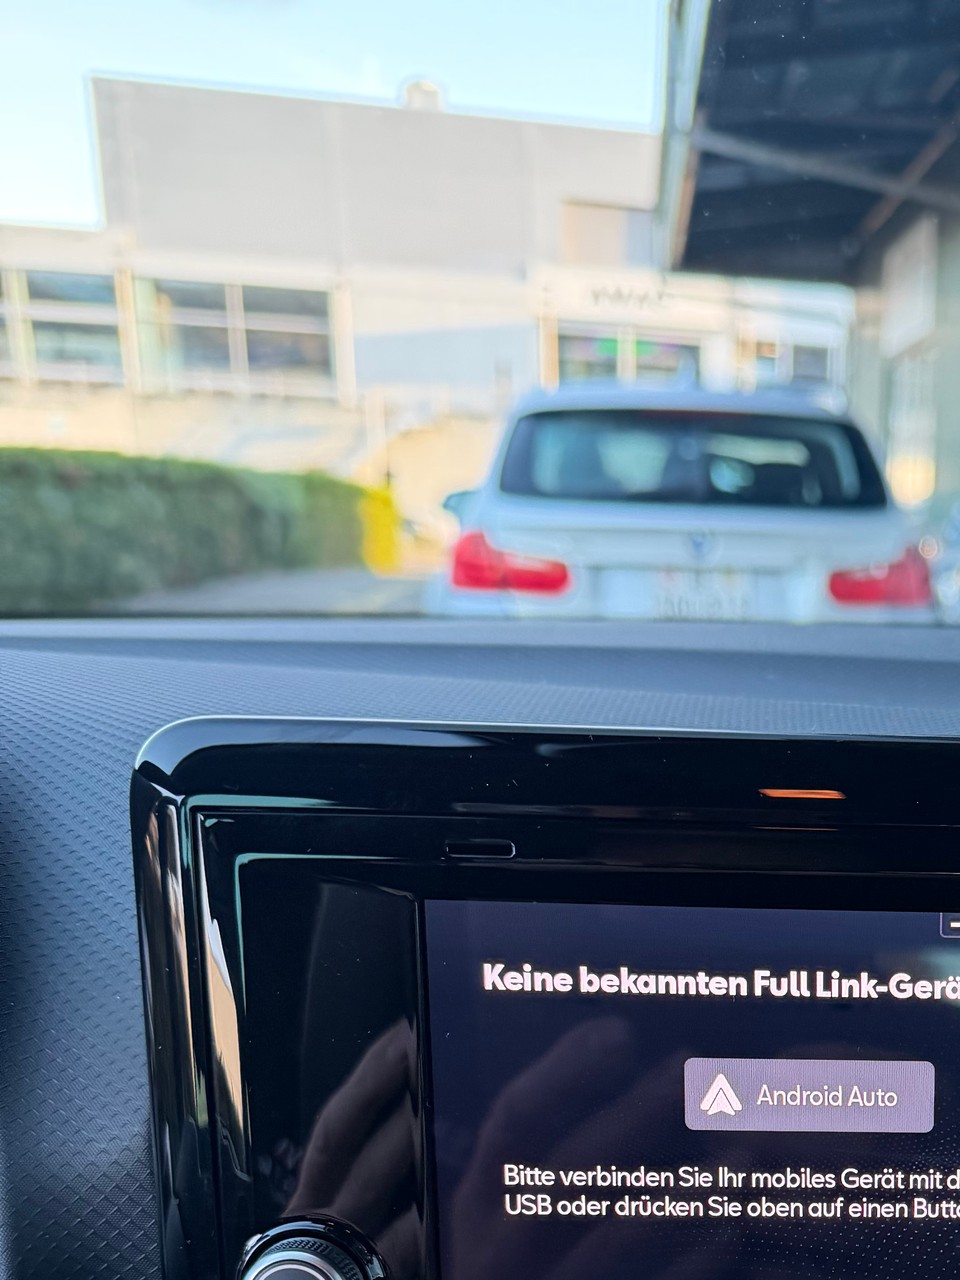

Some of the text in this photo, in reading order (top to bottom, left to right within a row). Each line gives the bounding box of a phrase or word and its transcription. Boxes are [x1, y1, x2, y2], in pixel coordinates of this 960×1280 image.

[483, 963, 573, 993] Keine
[580, 967, 747, 997] bekannten
[754, 970, 810, 997] Full
[757, 1083, 898, 1108] Android Auto
[503, 1165, 555, 1187] Bitte
[560, 1166, 674, 1188] verbinden
[678, 1168, 713, 1188] Sie
[719, 1168, 746, 1188] Ihr
[751, 1169, 836, 1189] mobiles
[840, 1169, 905, 1190] Gerät
[910, 1171, 942, 1190] mit
[504, 1195, 552, 1216] USB
[557, 1196, 610, 1217] oder
[615, 1197, 704, 1217] drücken
[708, 1198, 742, 1218] Sie
[747, 1198, 803, 1218] oben
[809, 1198, 844, 1219] auf
[848, 1200, 908, 1219] einen
